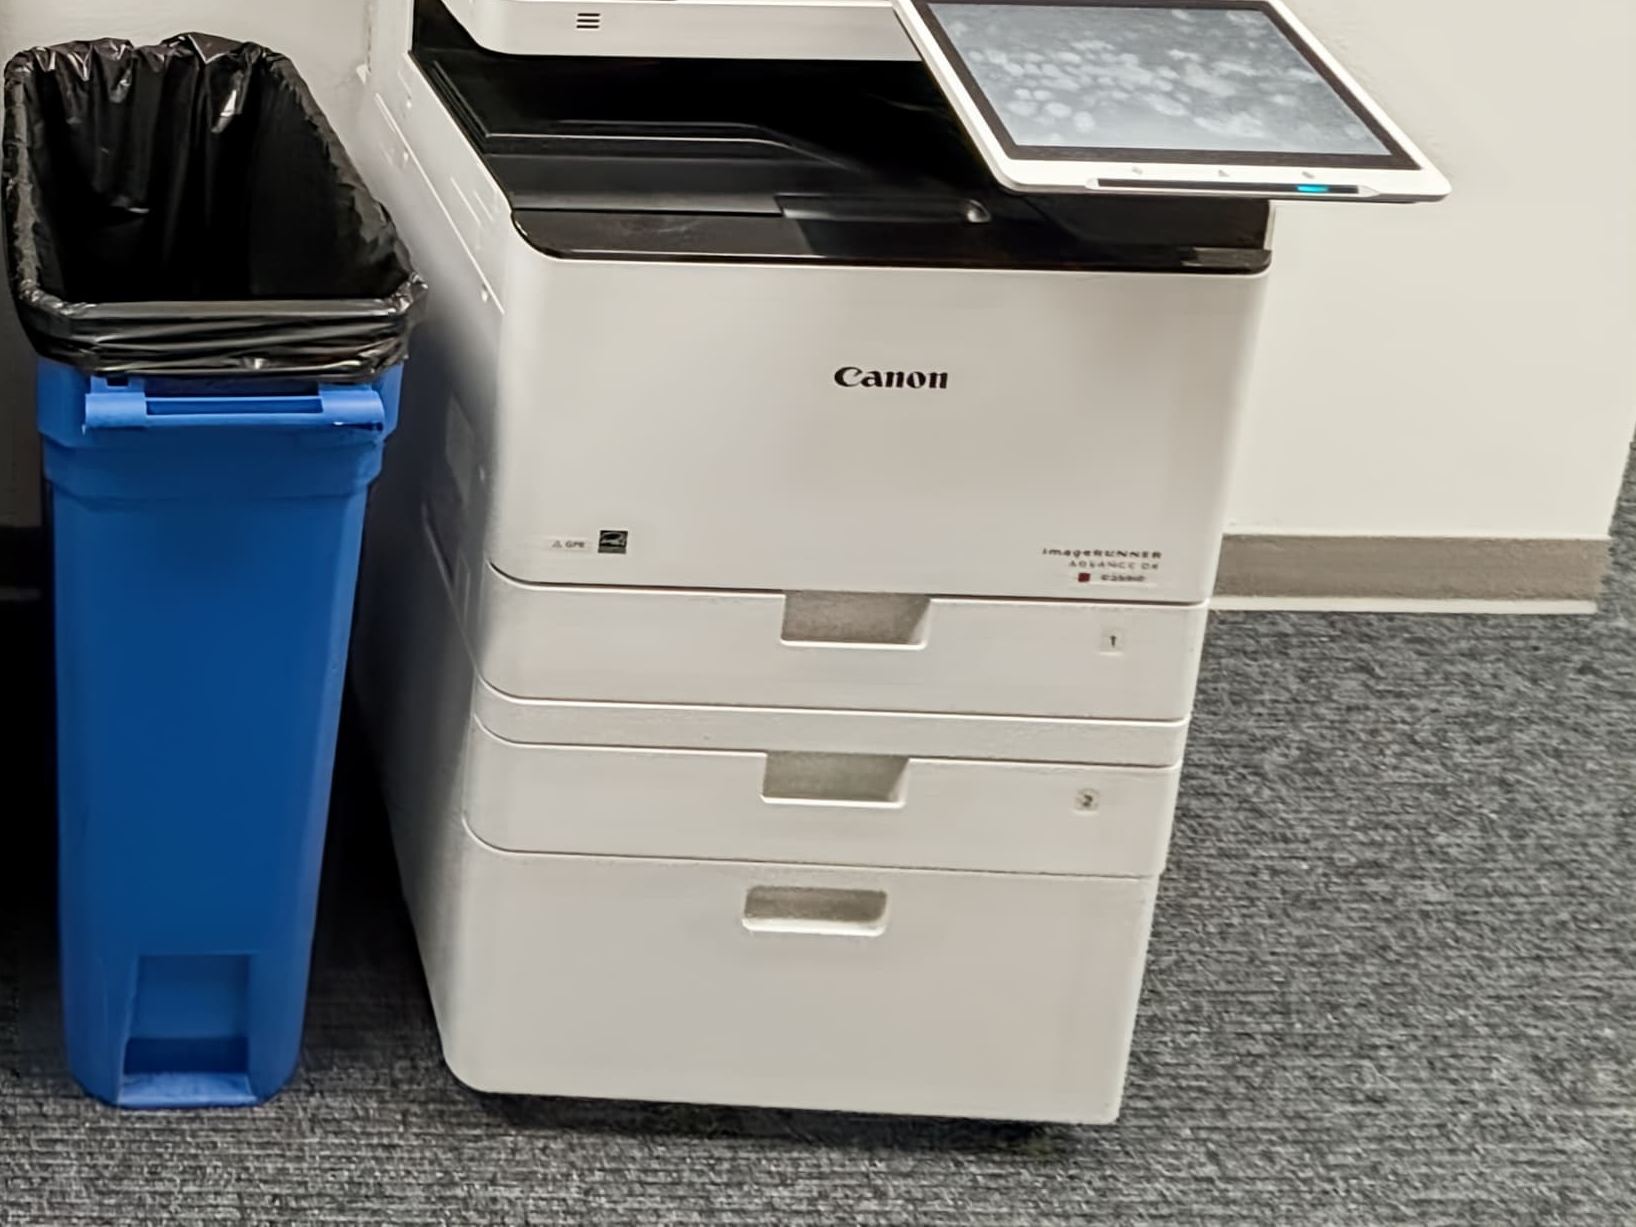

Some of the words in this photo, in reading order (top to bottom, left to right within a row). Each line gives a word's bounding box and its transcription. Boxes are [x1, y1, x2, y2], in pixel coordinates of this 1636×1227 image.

[834, 366, 948, 389] Canon
[1043, 548, 1161, 559] imageRUNNER
[1110, 635, 1117, 649] 1
